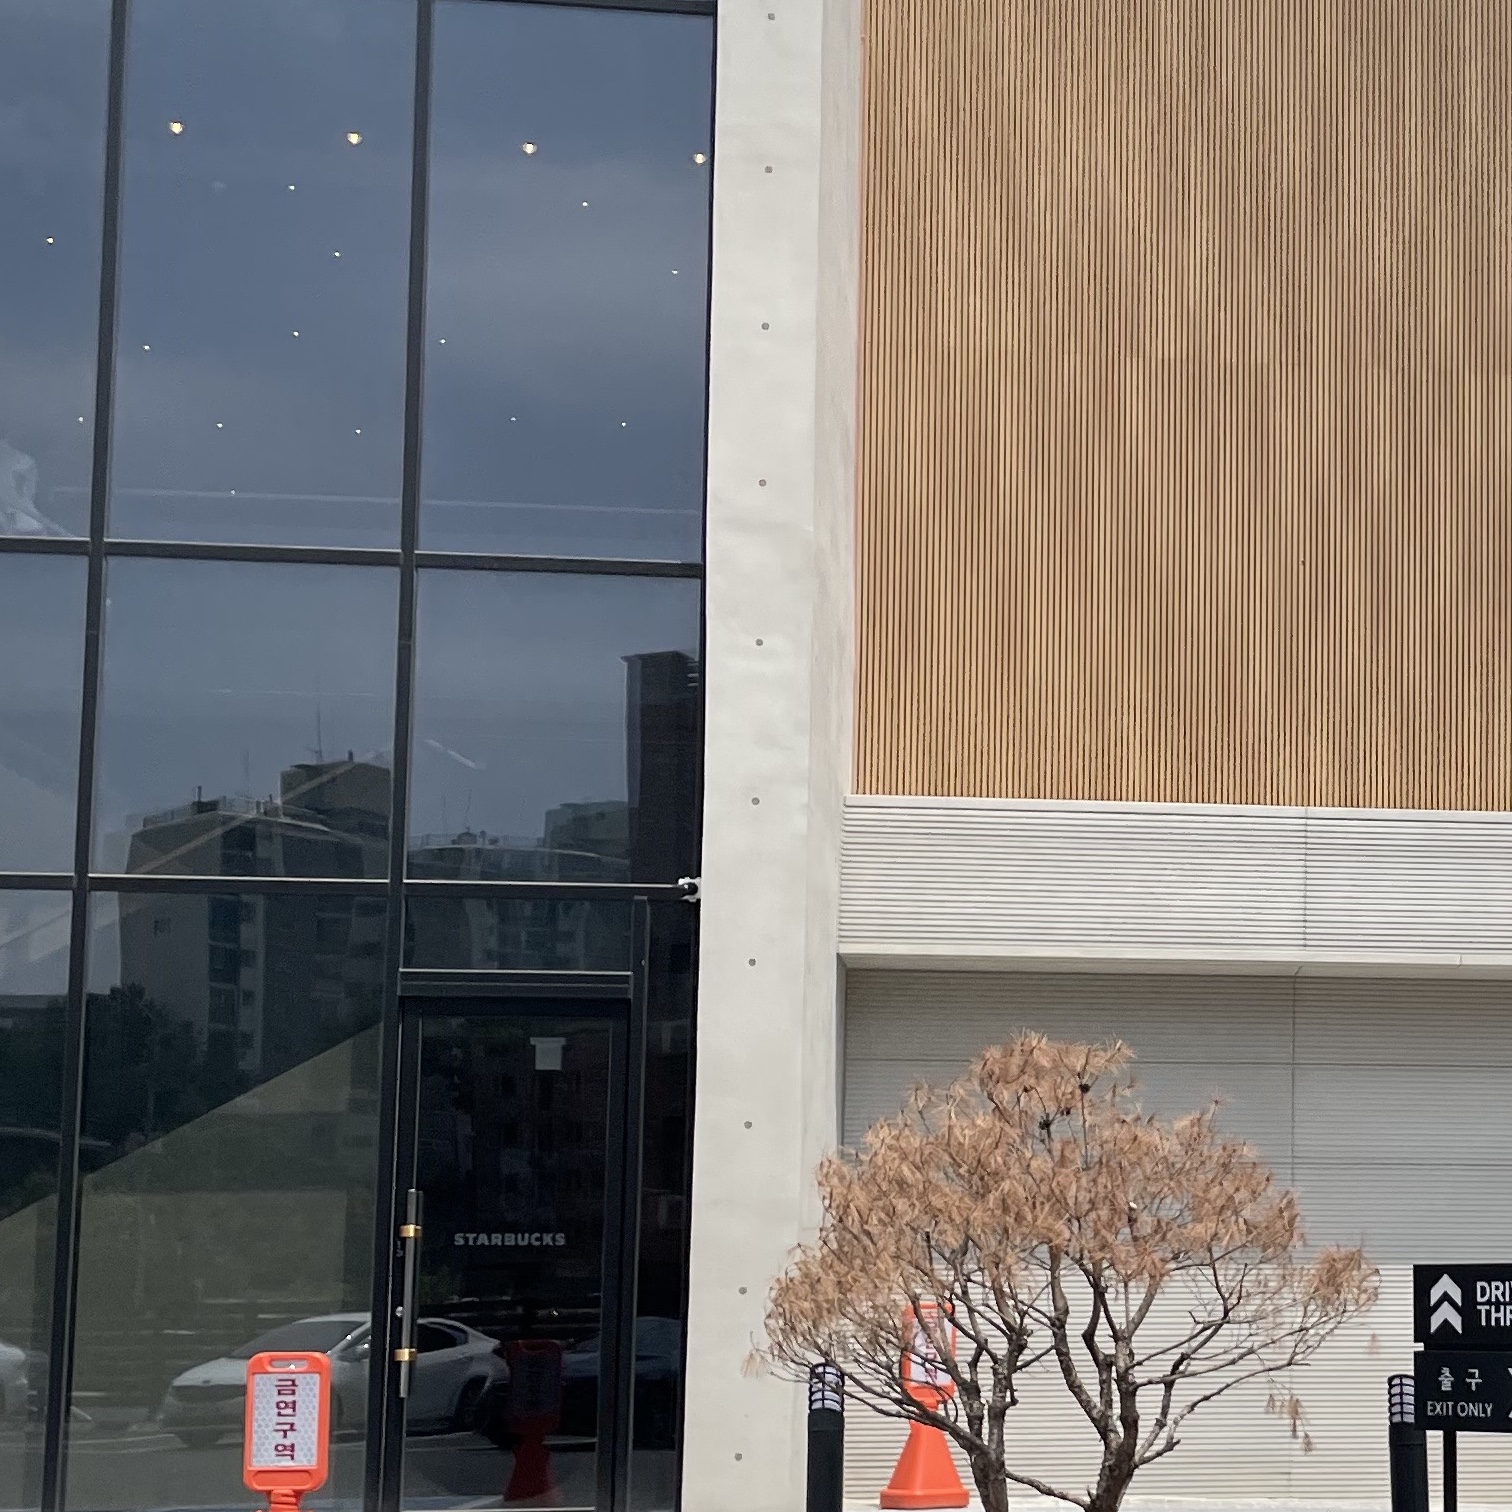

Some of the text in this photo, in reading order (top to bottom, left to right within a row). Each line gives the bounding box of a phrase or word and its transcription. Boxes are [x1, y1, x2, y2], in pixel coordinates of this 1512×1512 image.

[454, 1233, 566, 1247] STARBUCKS
[1427, 1401, 1493, 1418] EXIT ONLY
[274, 1378, 298, 1461] 금연구역
